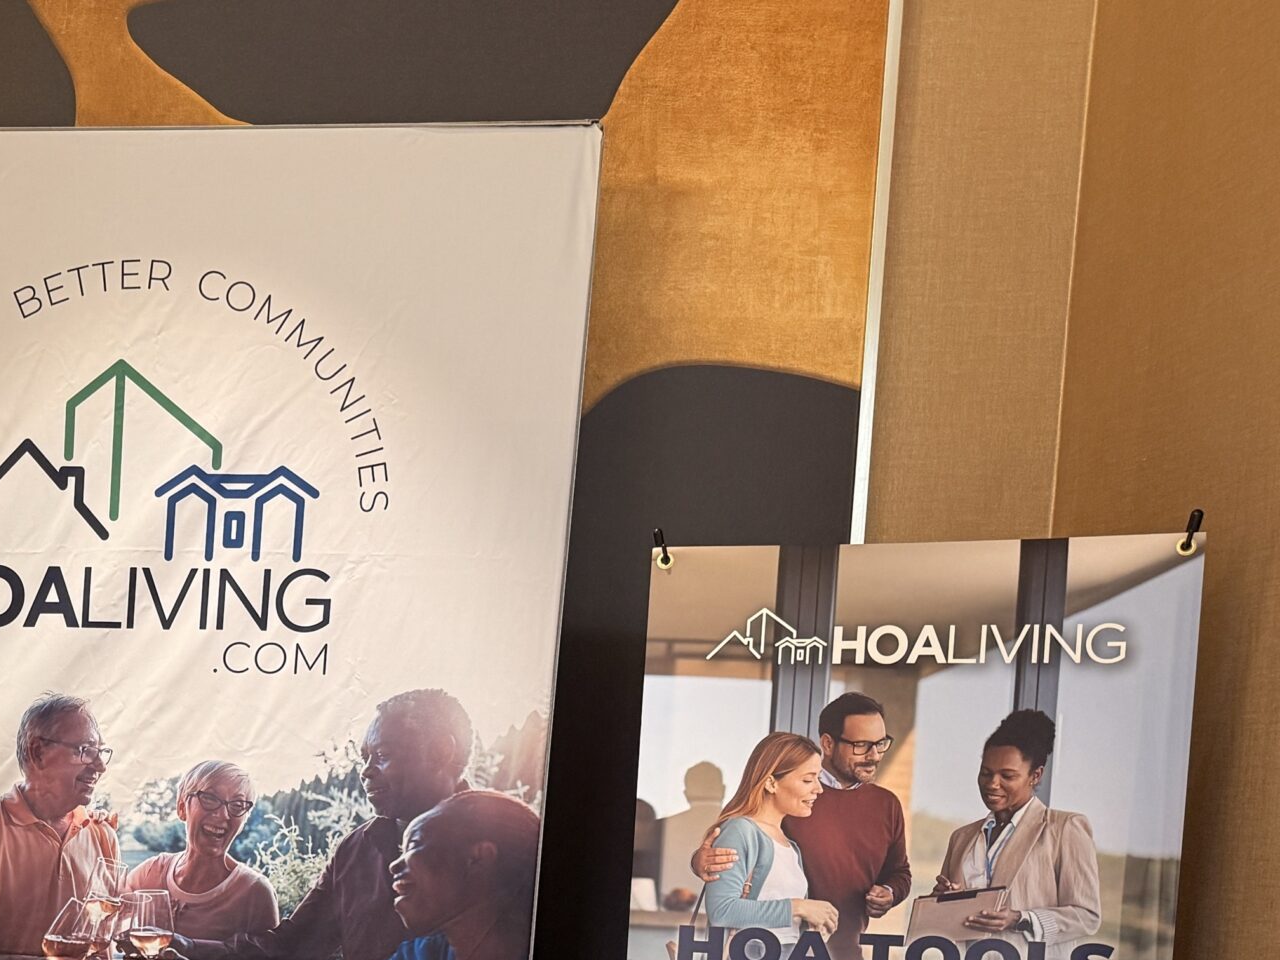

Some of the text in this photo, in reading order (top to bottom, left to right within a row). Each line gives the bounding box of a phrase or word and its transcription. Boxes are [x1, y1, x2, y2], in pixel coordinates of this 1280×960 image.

[13, 259, 172, 318] BETTER
[198, 270, 389, 513] COMMUNITIES
[212, 642, 329, 675] .COM
[833, 623, 1128, 664] HOALIVING
